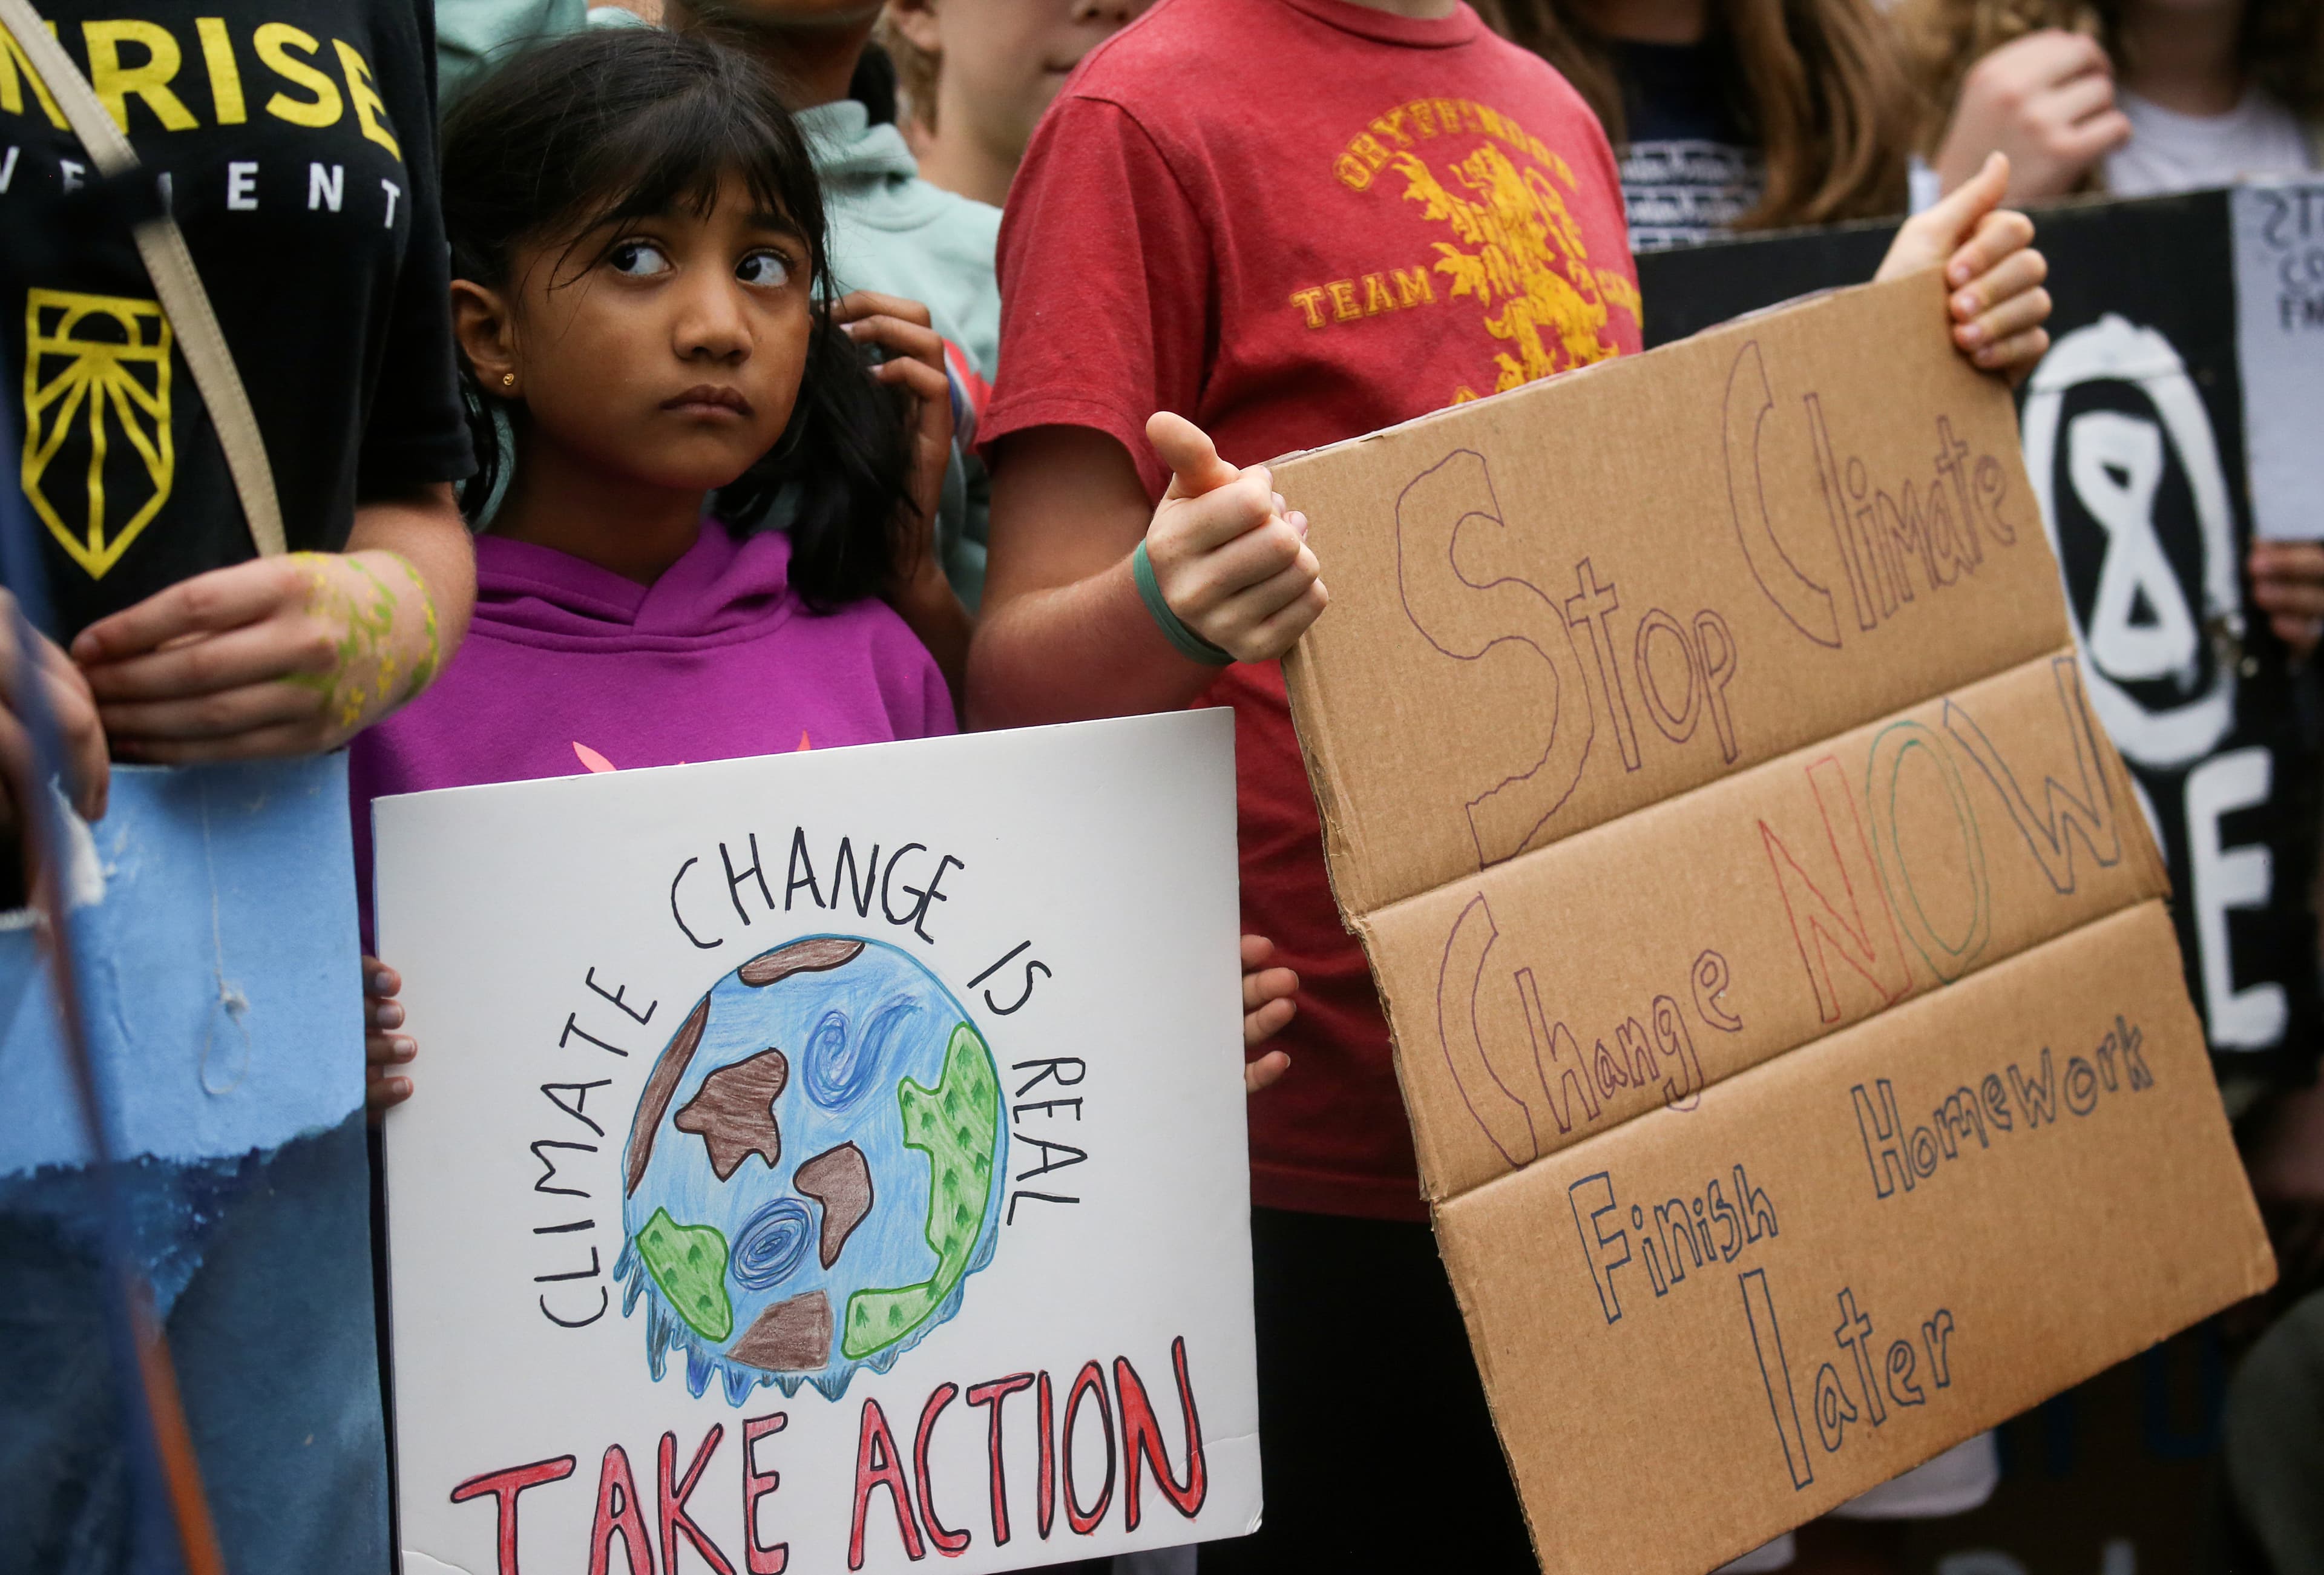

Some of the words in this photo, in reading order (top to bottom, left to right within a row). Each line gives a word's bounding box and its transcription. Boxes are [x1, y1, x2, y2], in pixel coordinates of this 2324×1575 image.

[0, 145, 401, 229] EENT
[1288, 265, 1438, 329] TEAM
[1395, 448, 1738, 873] Stop
[1723, 339, 2017, 649] Climate
[671, 825, 965, 949] CHANGE
[1437, 891, 1744, 1171] Change
[1758, 656, 2120, 1024] NOW
[967, 939, 1052, 1016] IS
[530, 966, 658, 1329] CLIMATE
[1003, 1057, 1088, 1226] REAL
[1567, 1163, 1779, 1325] Finish
[450, 1411, 790, 1575] TAKE
[847, 1335, 1208, 1572] ACTION
